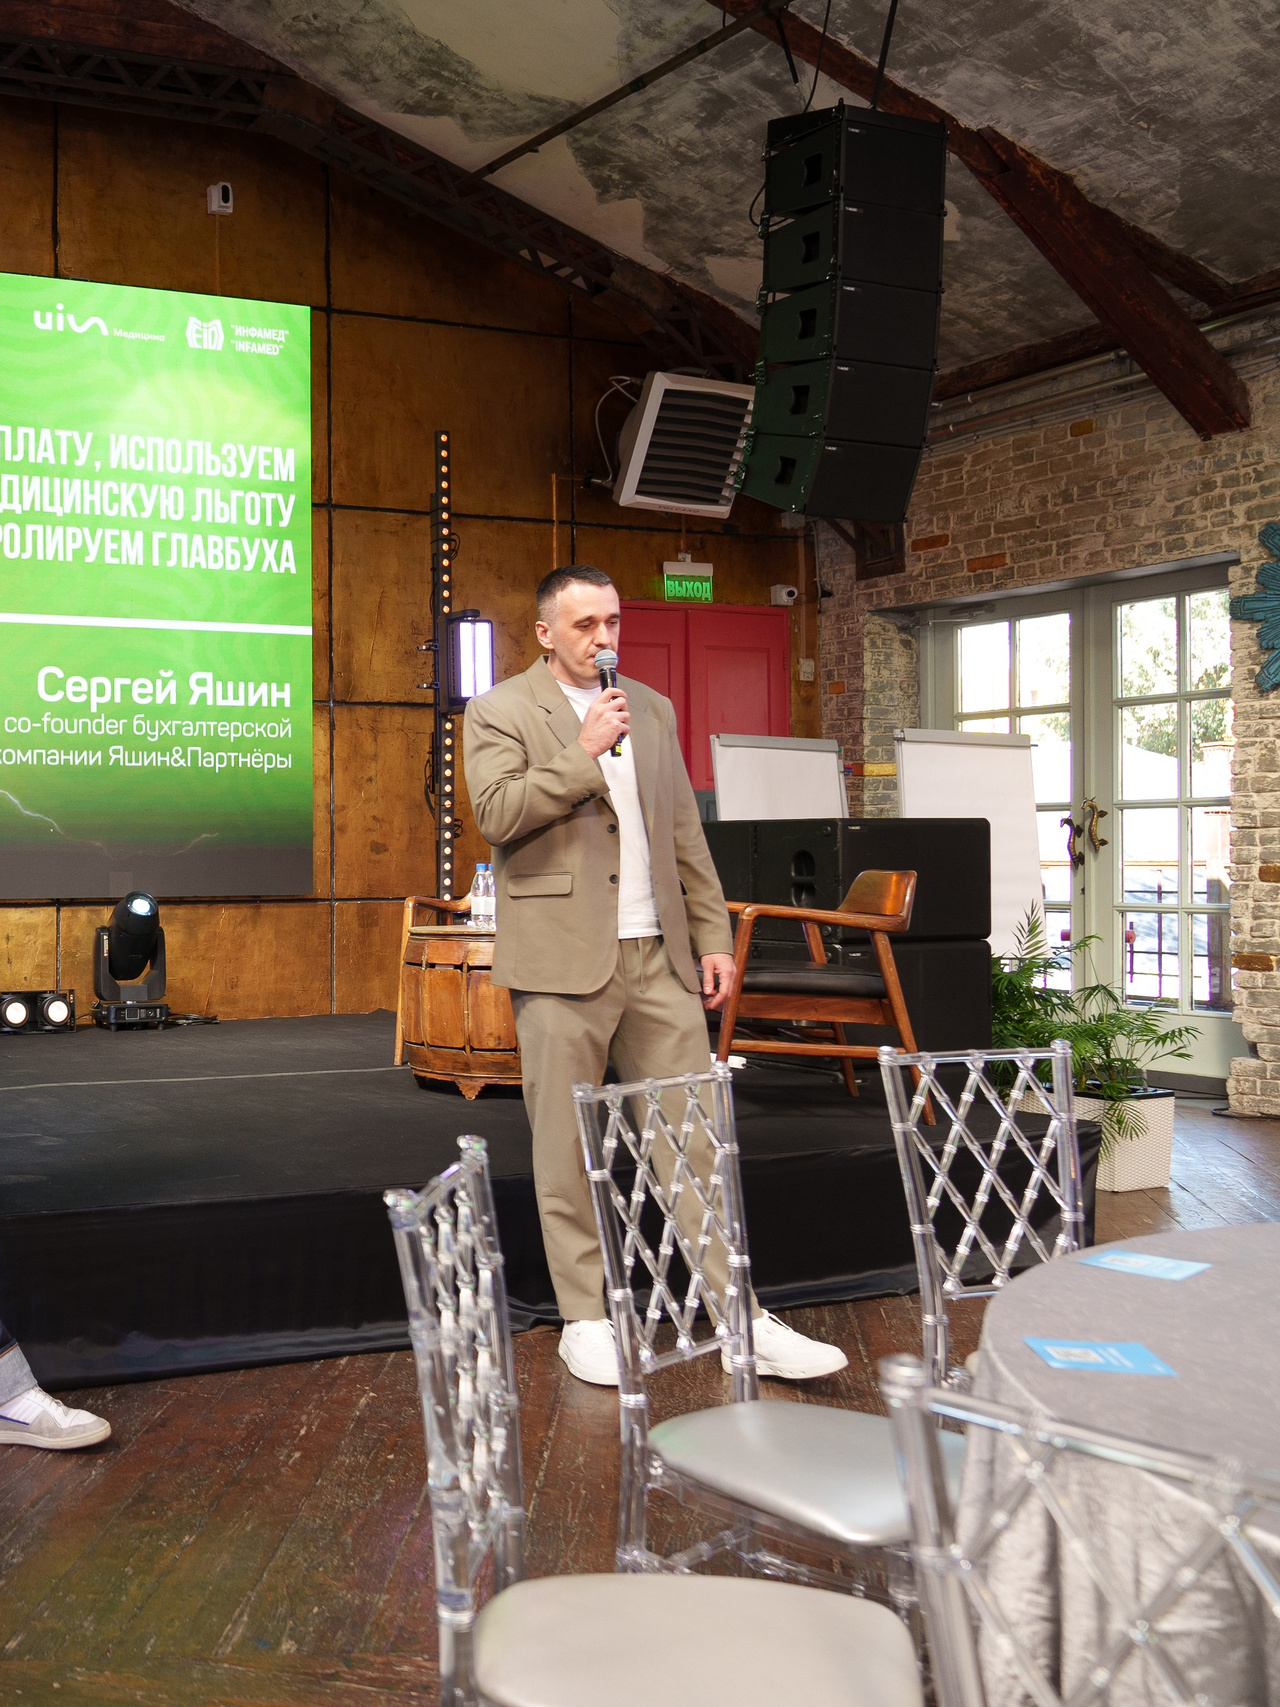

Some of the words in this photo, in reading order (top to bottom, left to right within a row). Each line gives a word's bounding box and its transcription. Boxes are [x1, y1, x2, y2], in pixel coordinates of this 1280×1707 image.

[109, 432, 296, 483] ИСПОЛЬЗУЕМ
[192, 491, 296, 528] ЛЬГОТУ
[151, 530, 297, 574] ГЛАВБУХА
[666, 580, 712, 601] ВЫХОД
[37, 665, 177, 713] Сергей
[188, 671, 291, 708] Яшин
[4, 711, 128, 735] co-founder
[132, 713, 292, 743] бухгалтерской
[108, 745, 292, 774] Яшин&Партнёры
